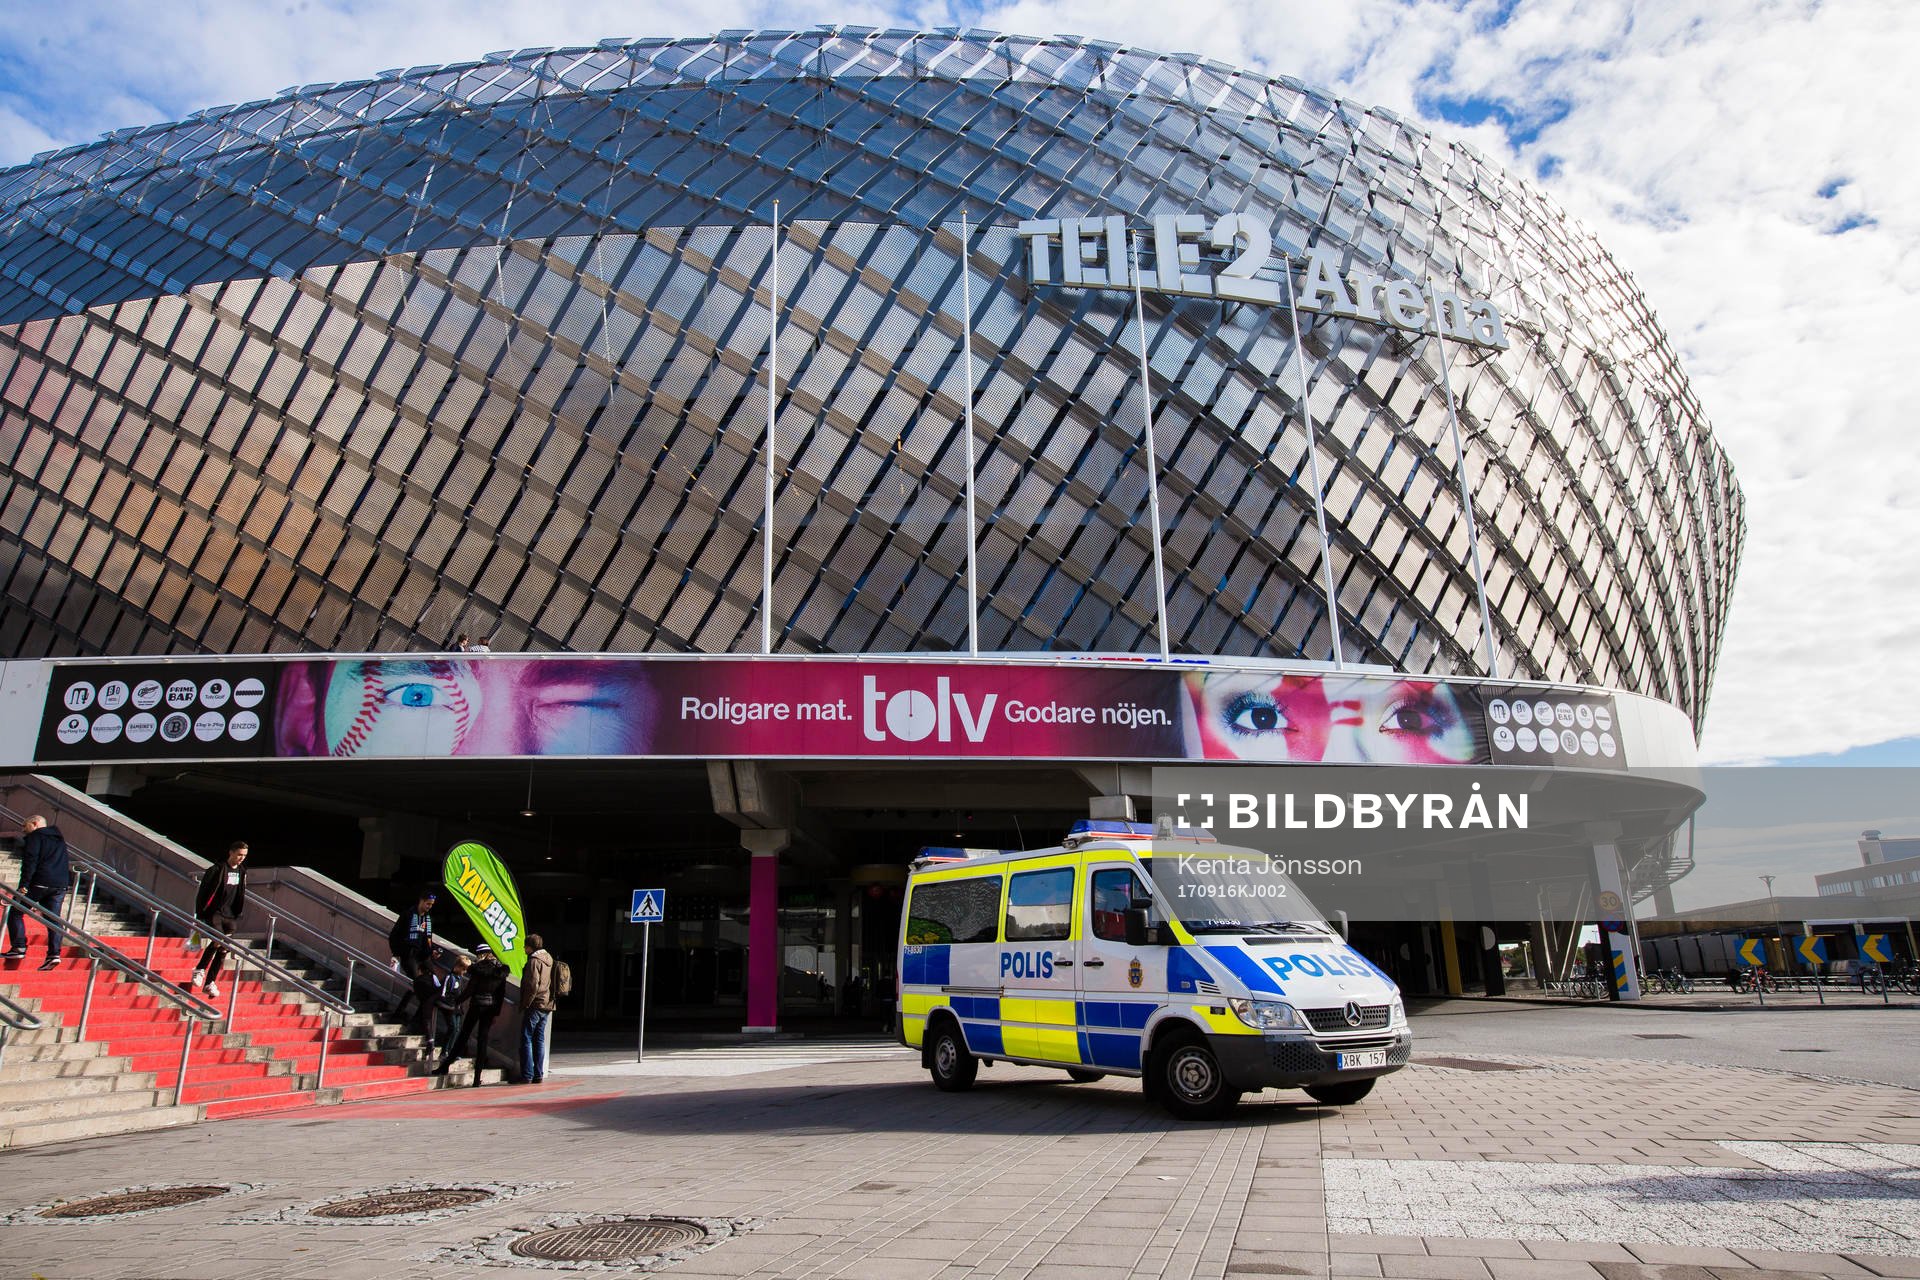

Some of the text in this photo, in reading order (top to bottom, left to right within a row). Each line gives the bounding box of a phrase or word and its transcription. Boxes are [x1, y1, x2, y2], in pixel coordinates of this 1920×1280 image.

[1018, 212, 1509, 351] TELE2 Arena
[168, 692, 194, 701] BAR
[681, 696, 853, 724] Roligare mat.
[863, 675, 998, 743] tolv
[1004, 699, 1173, 728] Godare nöjen.
[1600, 896, 1617, 907] 30
[1001, 951, 1053, 979] POLIS
[1263, 954, 1372, 981] POLIS
[1343, 1052, 1385, 1067] XBK 157
